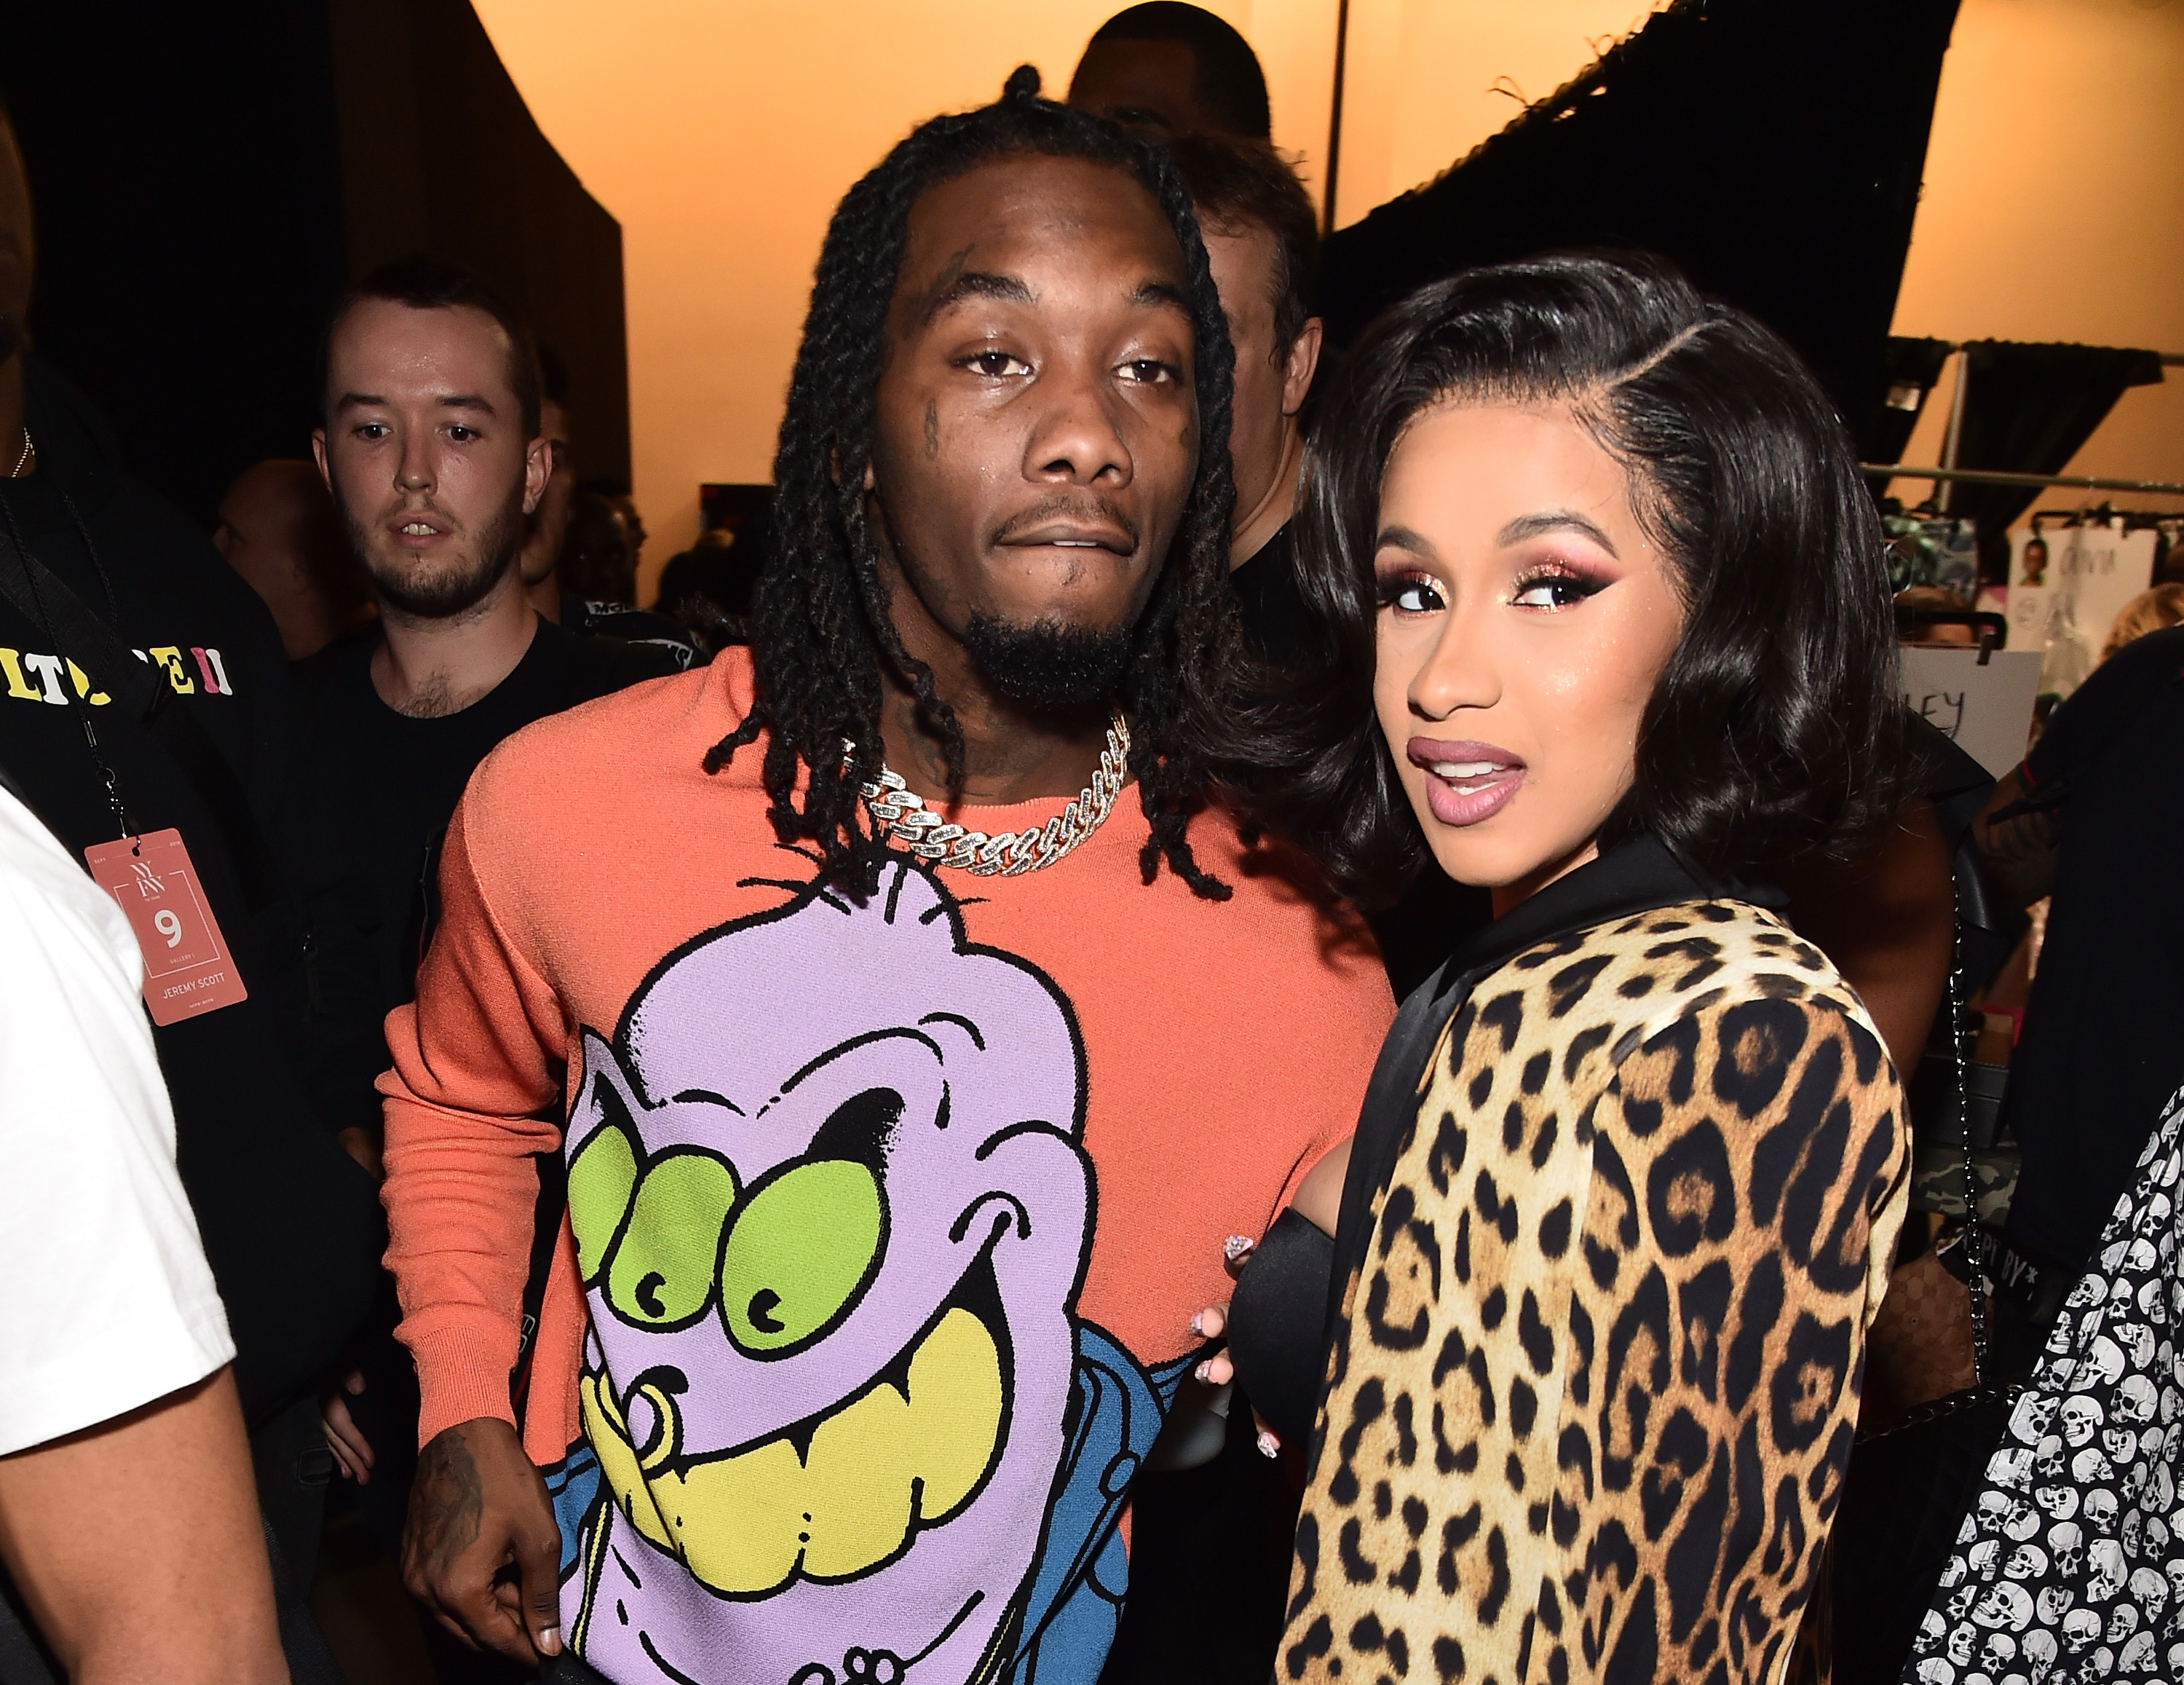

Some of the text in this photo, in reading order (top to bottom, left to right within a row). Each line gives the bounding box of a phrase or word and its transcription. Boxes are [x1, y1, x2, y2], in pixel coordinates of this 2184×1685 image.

[154, 909, 182, 947] 9
[170, 954, 192, 964] GALLERY
[162, 972, 226, 999] JEREMY SCOTT
